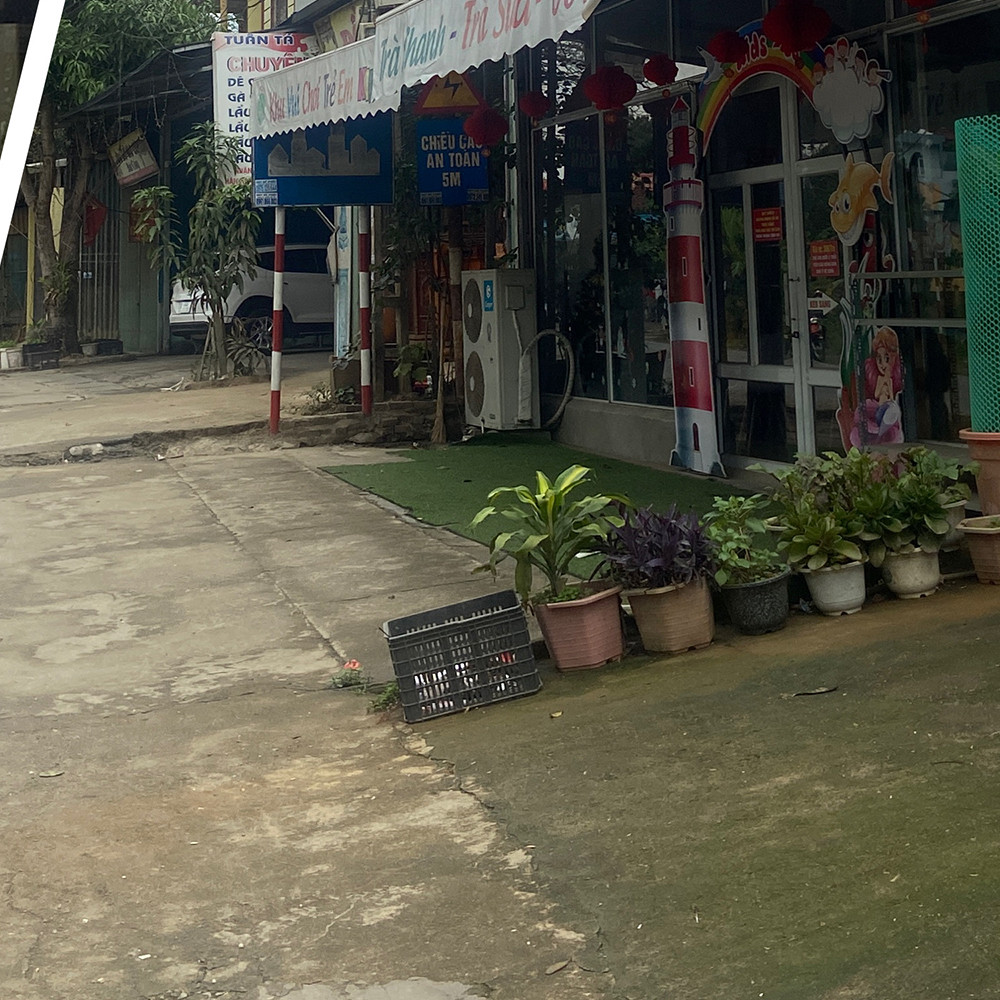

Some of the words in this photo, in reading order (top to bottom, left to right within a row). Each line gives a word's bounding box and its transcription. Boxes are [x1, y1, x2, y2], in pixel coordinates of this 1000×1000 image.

[269, 92, 285, 122] Khu
[287, 83, 300, 119] Vui
[302, 76, 321, 115] Chơi
[323, 69, 337, 109] Trẻ
[337, 69, 354, 106] Em
[427, 153, 444, 168] AN
[448, 149, 481, 168] TOÀN
[442, 172, 461, 187] 5M
